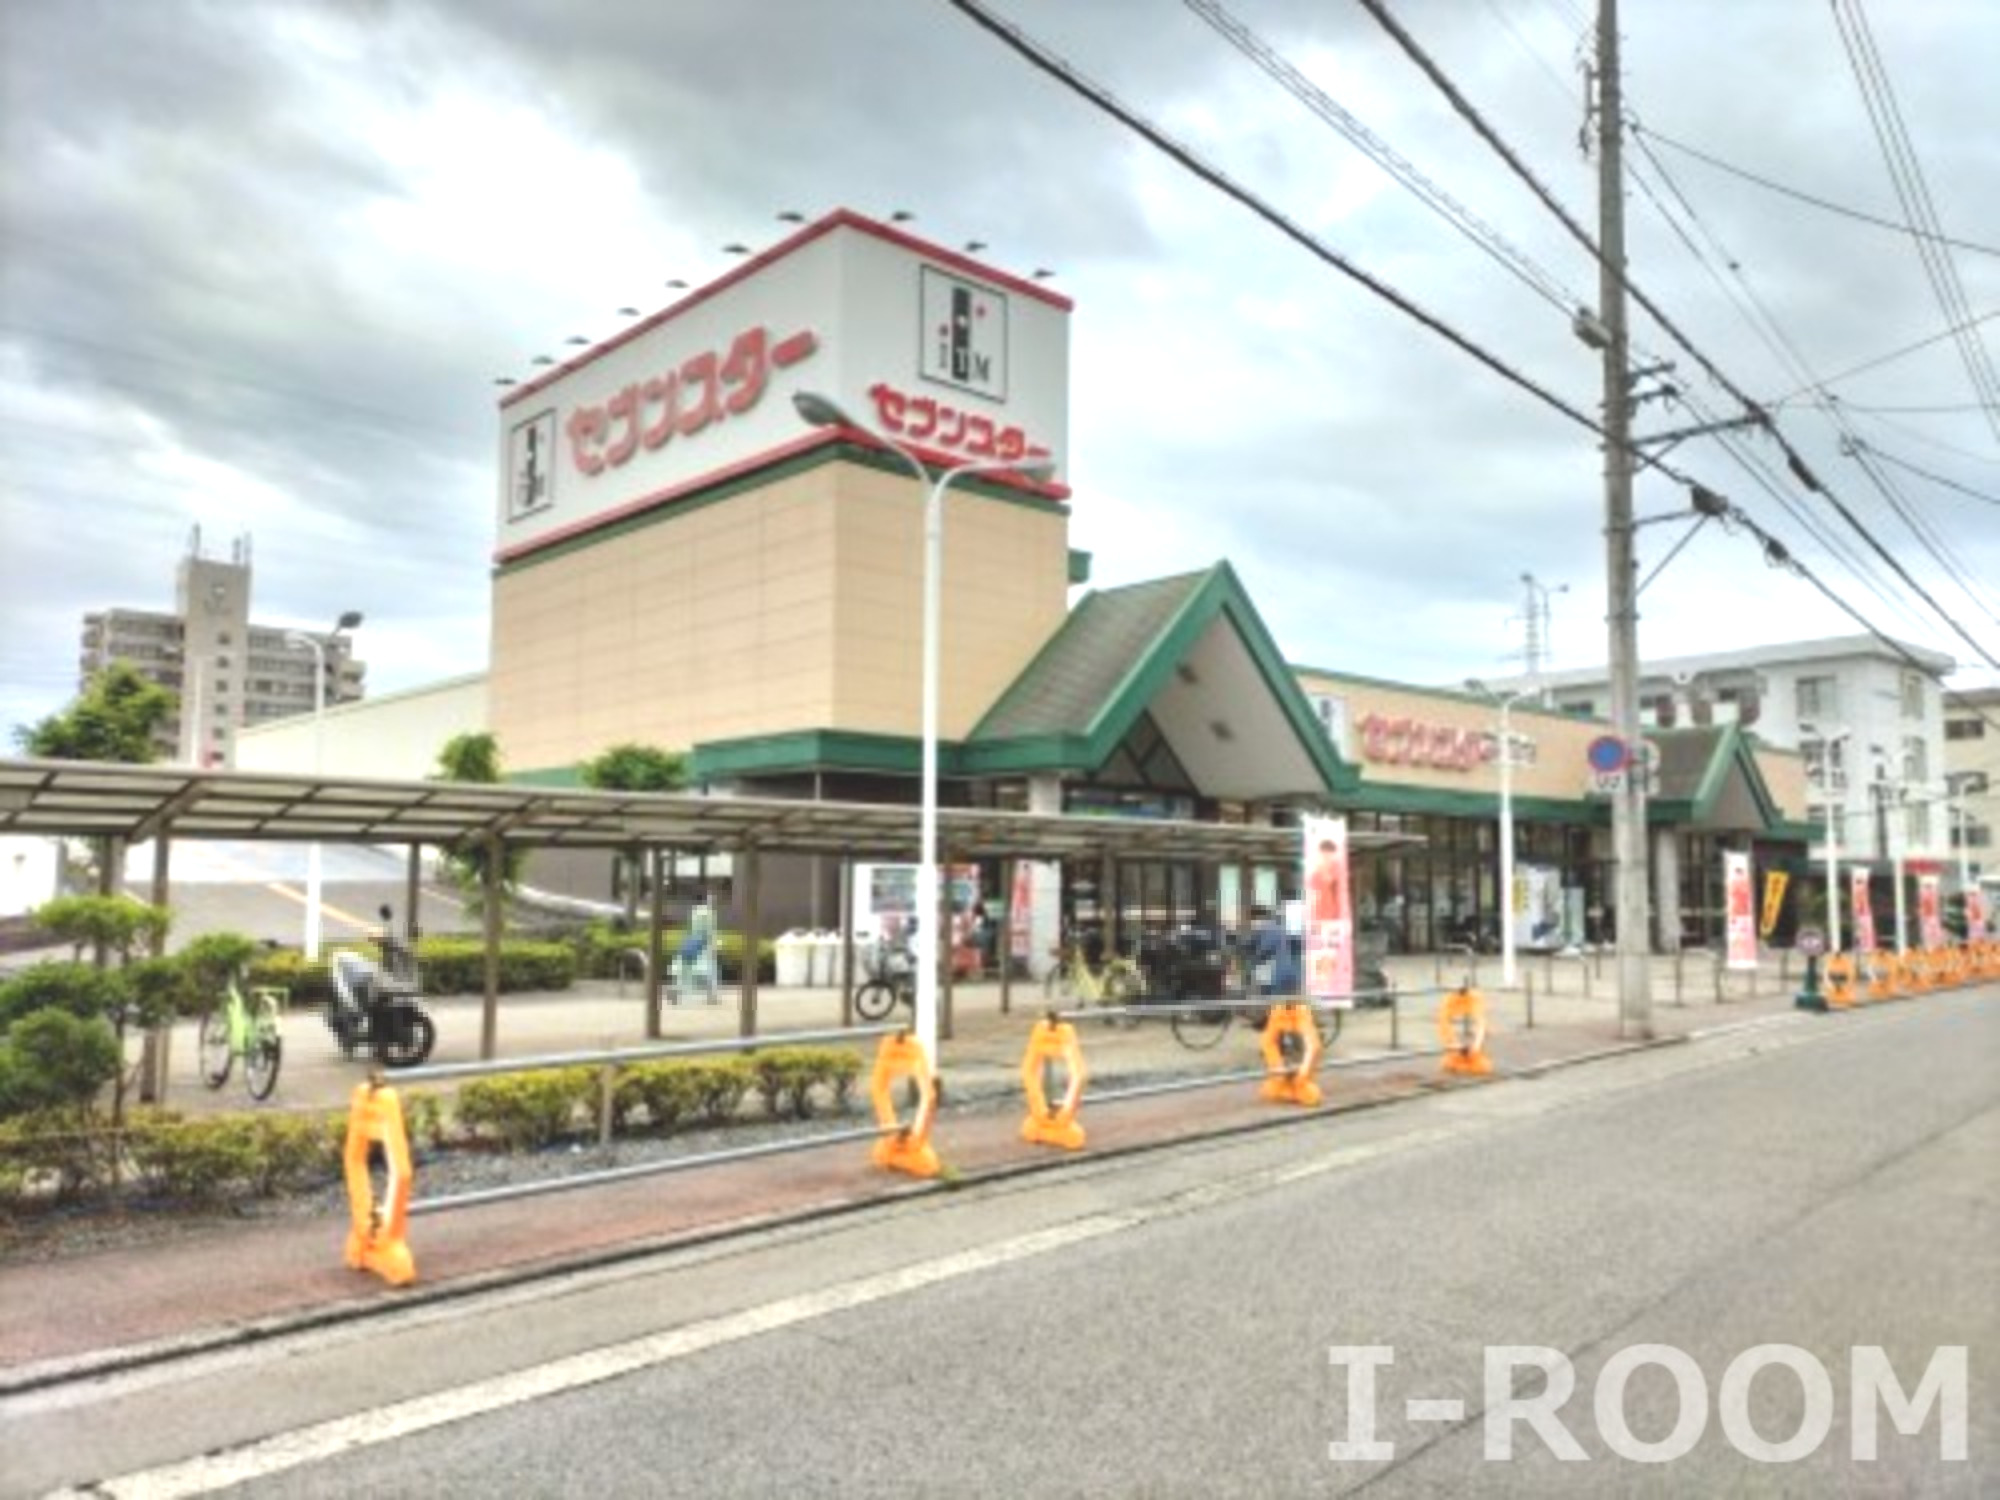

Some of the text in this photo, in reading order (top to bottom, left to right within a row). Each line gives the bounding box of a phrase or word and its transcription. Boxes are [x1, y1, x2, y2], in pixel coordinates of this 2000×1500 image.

[566, 325, 816, 477] セブンスター
[868, 382, 1052, 461] セブンスター
